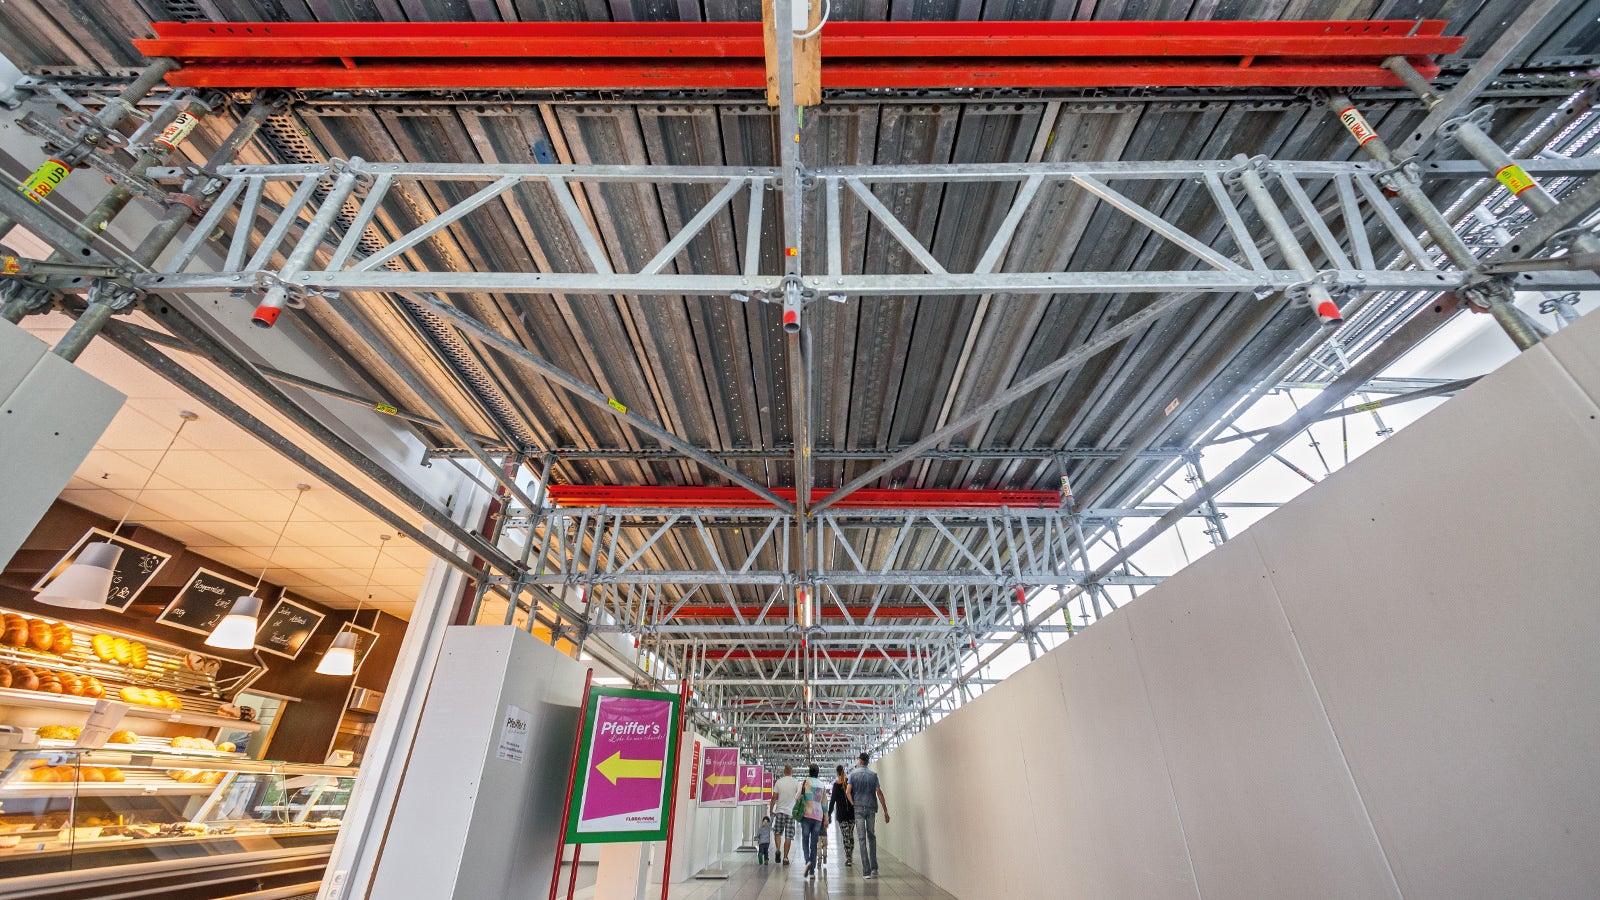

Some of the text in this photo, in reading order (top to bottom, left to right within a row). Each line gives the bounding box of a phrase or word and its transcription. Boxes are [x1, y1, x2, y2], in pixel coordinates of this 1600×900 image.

[176, 113, 189, 125] UP
[1342, 113, 1368, 140] PERI UP
[47, 167, 65, 184] UP
[600, 721, 661, 735] Pfeiffer's
